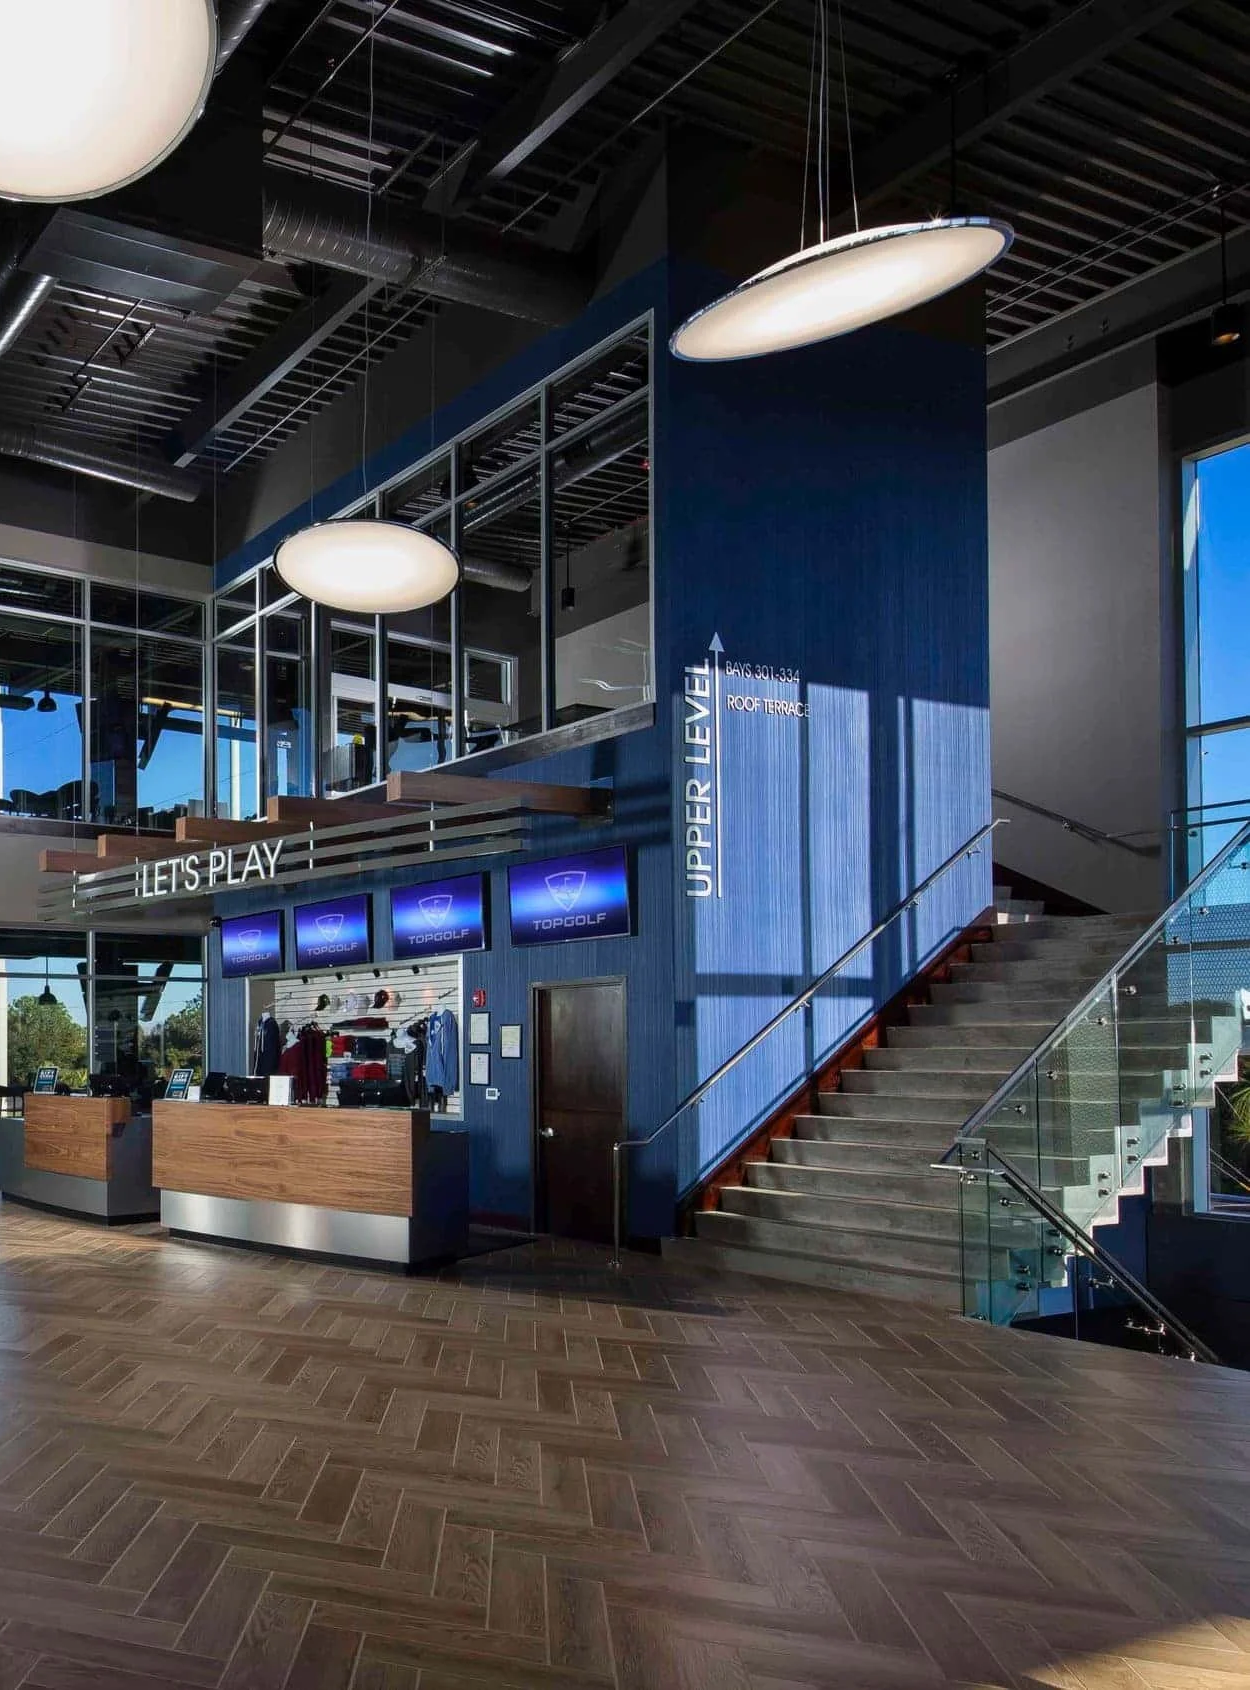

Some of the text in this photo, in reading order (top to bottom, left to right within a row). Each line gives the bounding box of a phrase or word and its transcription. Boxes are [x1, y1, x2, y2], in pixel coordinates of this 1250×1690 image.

[726, 660, 800, 683] BAYS 301-334
[727, 694, 811, 717] ROOF TERRACE
[684, 658, 712, 898] UPPER LEVEL
[142, 839, 283, 898] LET'S PLAY
[533, 912, 607, 931] TOPGOLF
[408, 928, 470, 945] TOPGOLF
[231, 952, 272, 964] TOPGOLF
[307, 941, 358, 956] TOPGOLF
